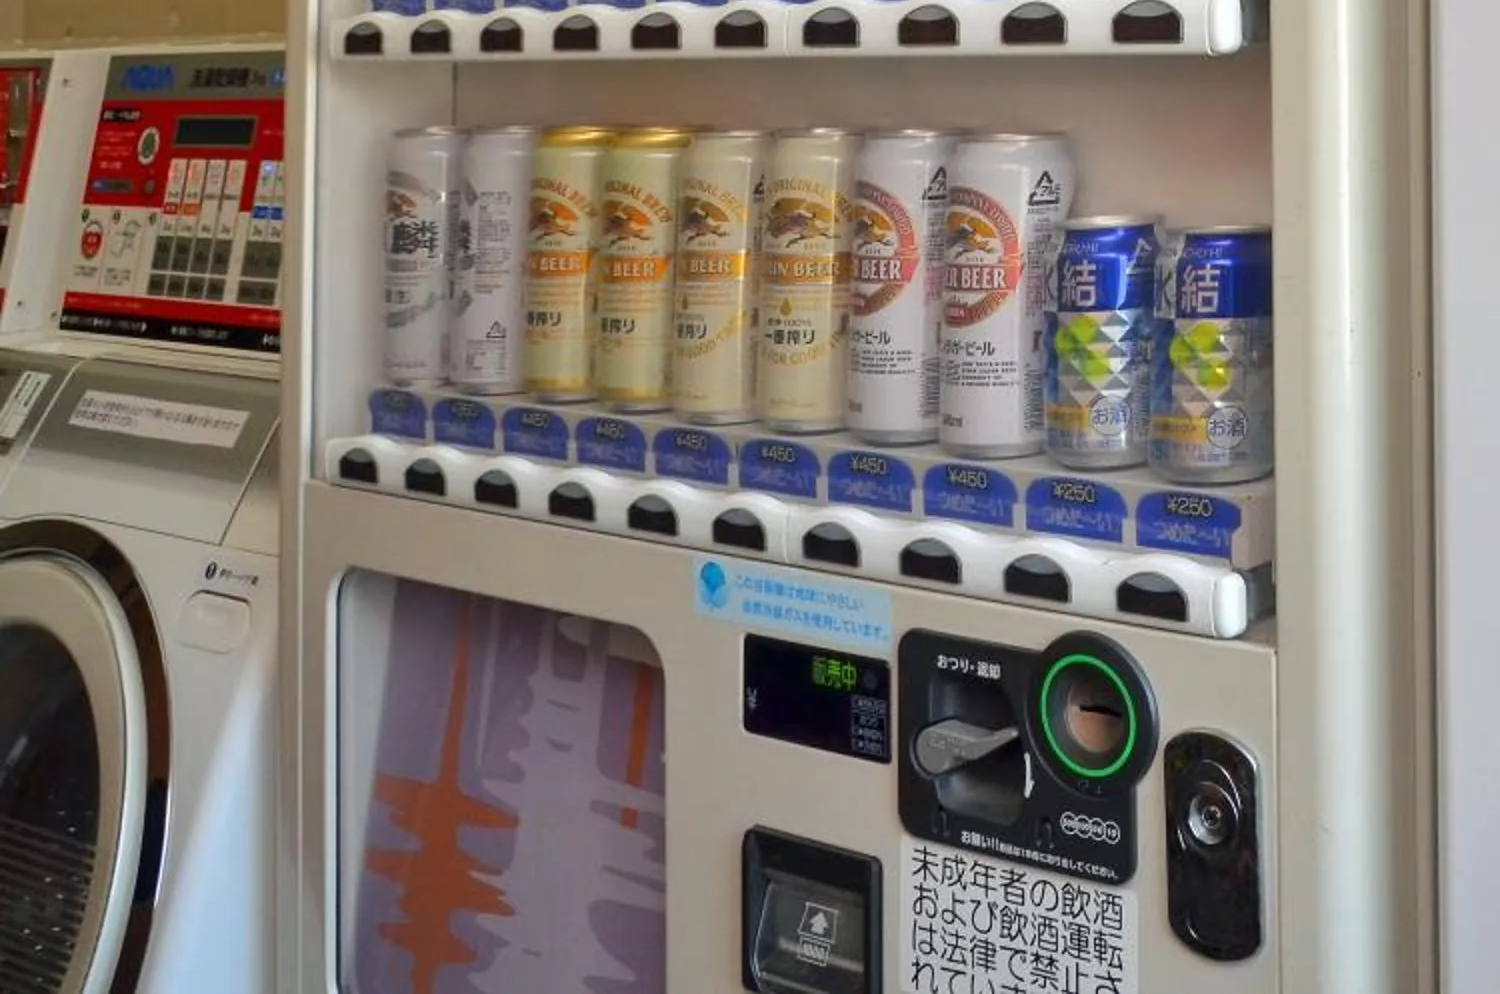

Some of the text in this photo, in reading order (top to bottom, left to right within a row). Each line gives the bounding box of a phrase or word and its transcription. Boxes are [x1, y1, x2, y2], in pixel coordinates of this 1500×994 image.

[860, 259, 902, 281] BEER
[961, 267, 1007, 289] BEER
[1062, 258, 1098, 313] 結
[764, 328, 817, 347] 一番搾り
[1091, 406, 1129, 426] お酒
[1210, 416, 1248, 438] お酒
[948, 466, 988, 489] ¥450
[1053, 481, 1096, 504] ¥250
[1167, 496, 1213, 518] ¥250
[911, 845, 1124, 932] 未成年者の飲酒
[911, 882, 1124, 972] および飲酒運転
